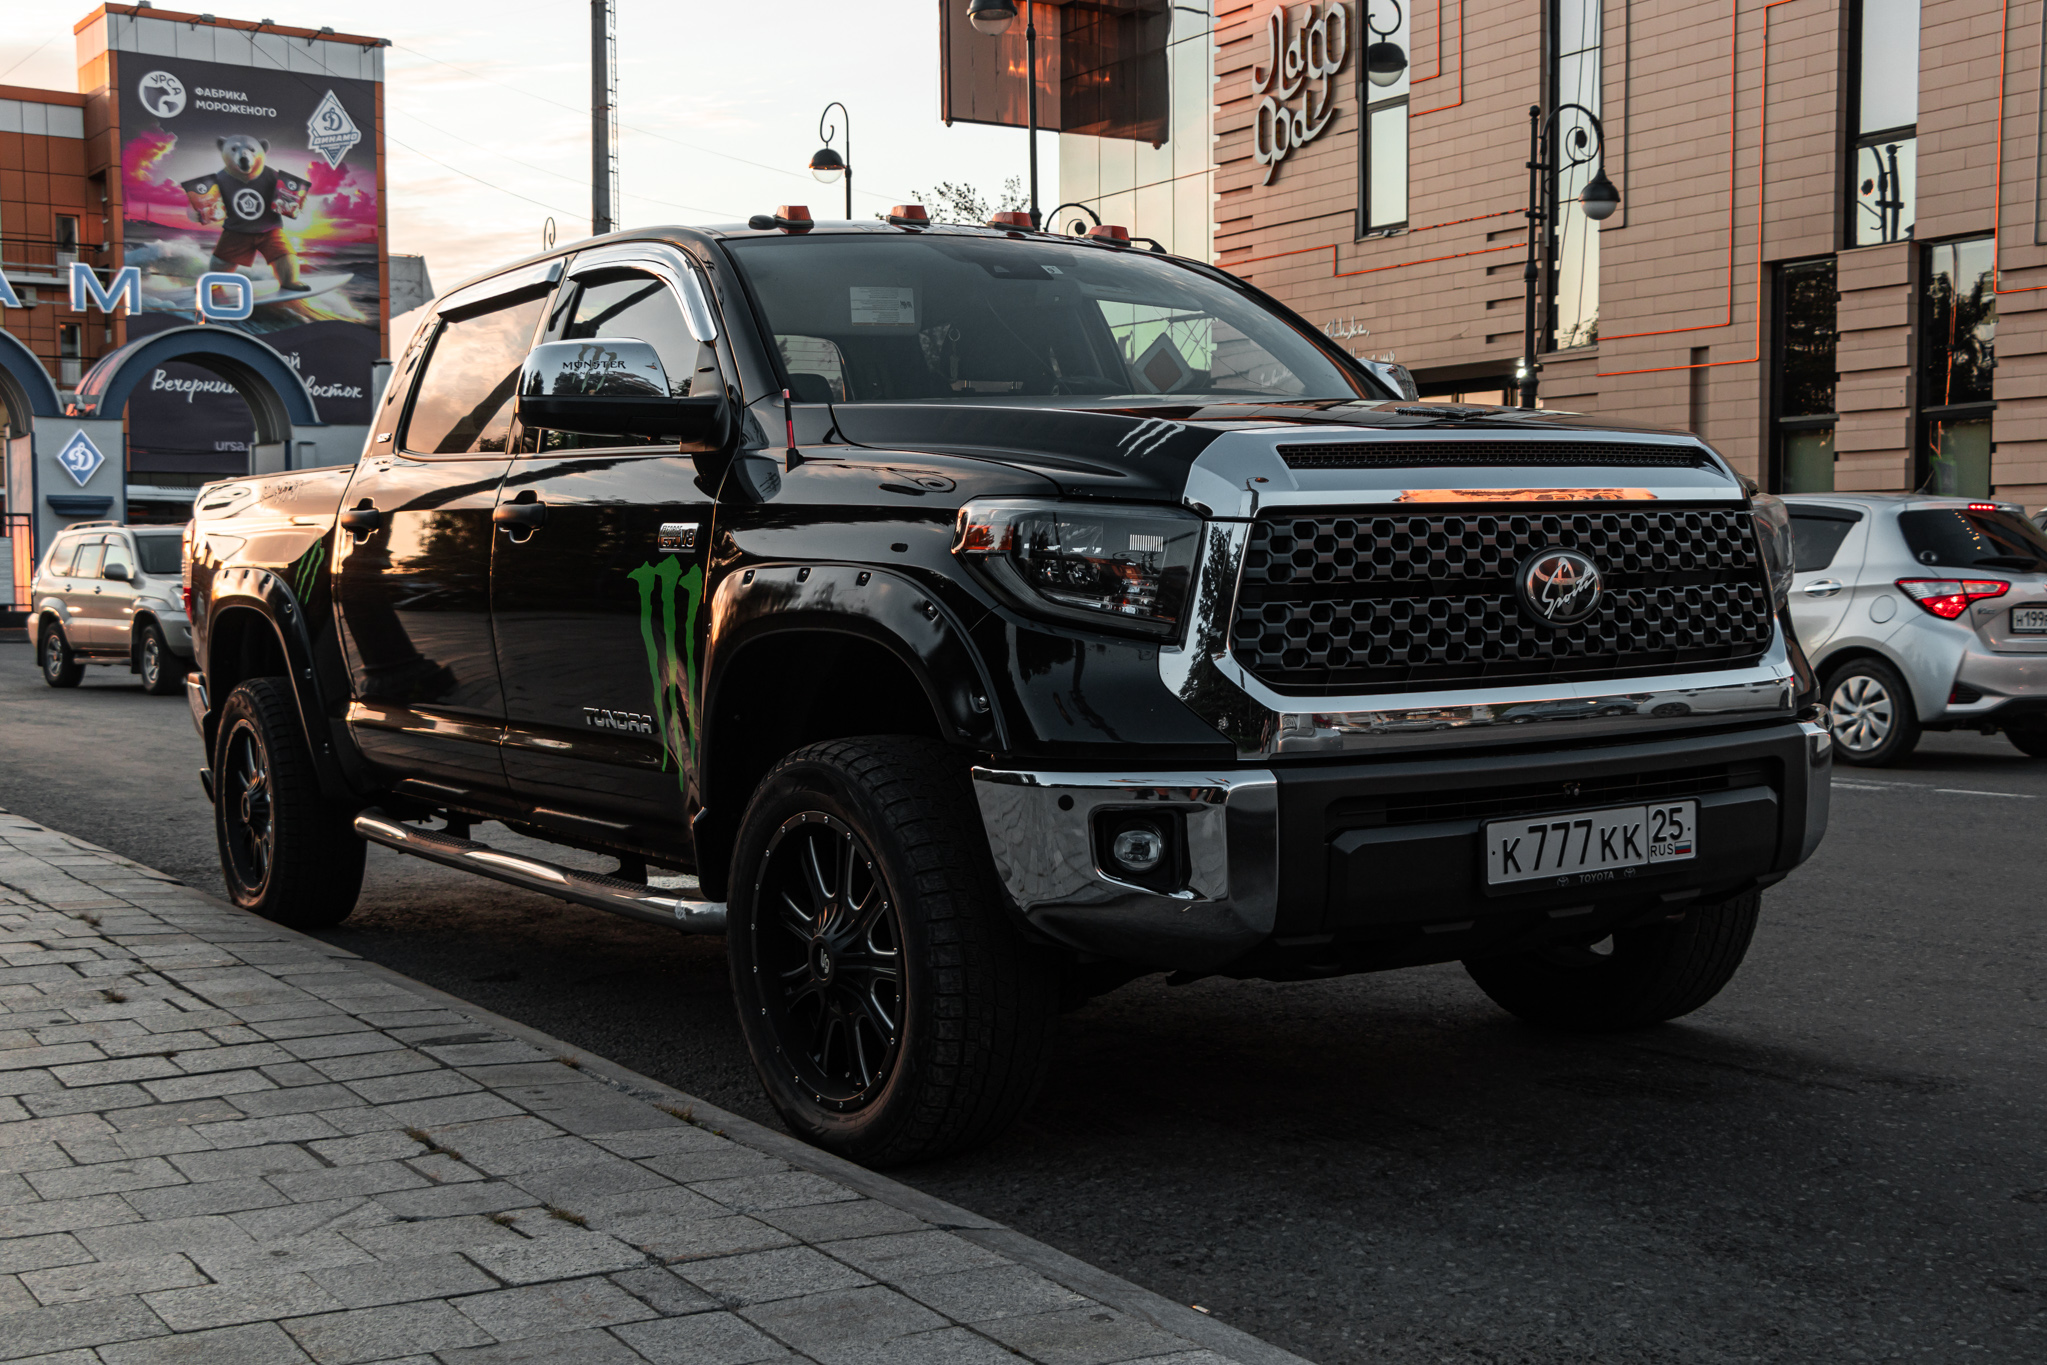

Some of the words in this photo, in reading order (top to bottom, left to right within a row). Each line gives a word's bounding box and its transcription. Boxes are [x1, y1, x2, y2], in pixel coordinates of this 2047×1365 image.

[150, 74, 182, 96] УРСА
[195, 87, 249, 102] ФАБРИКА
[195, 100, 278, 118] МОРОЖЕНОГО
[312, 132, 359, 145] ДИНАМО
[562, 359, 626, 371] MONSTER
[152, 369, 239, 403] Вечерни
[583, 706, 654, 735] TUNDRA
[1651, 806, 1684, 843] 25
[1649, 843, 1675, 857] RUS
[1579, 871, 1615, 884] TOYOTA
